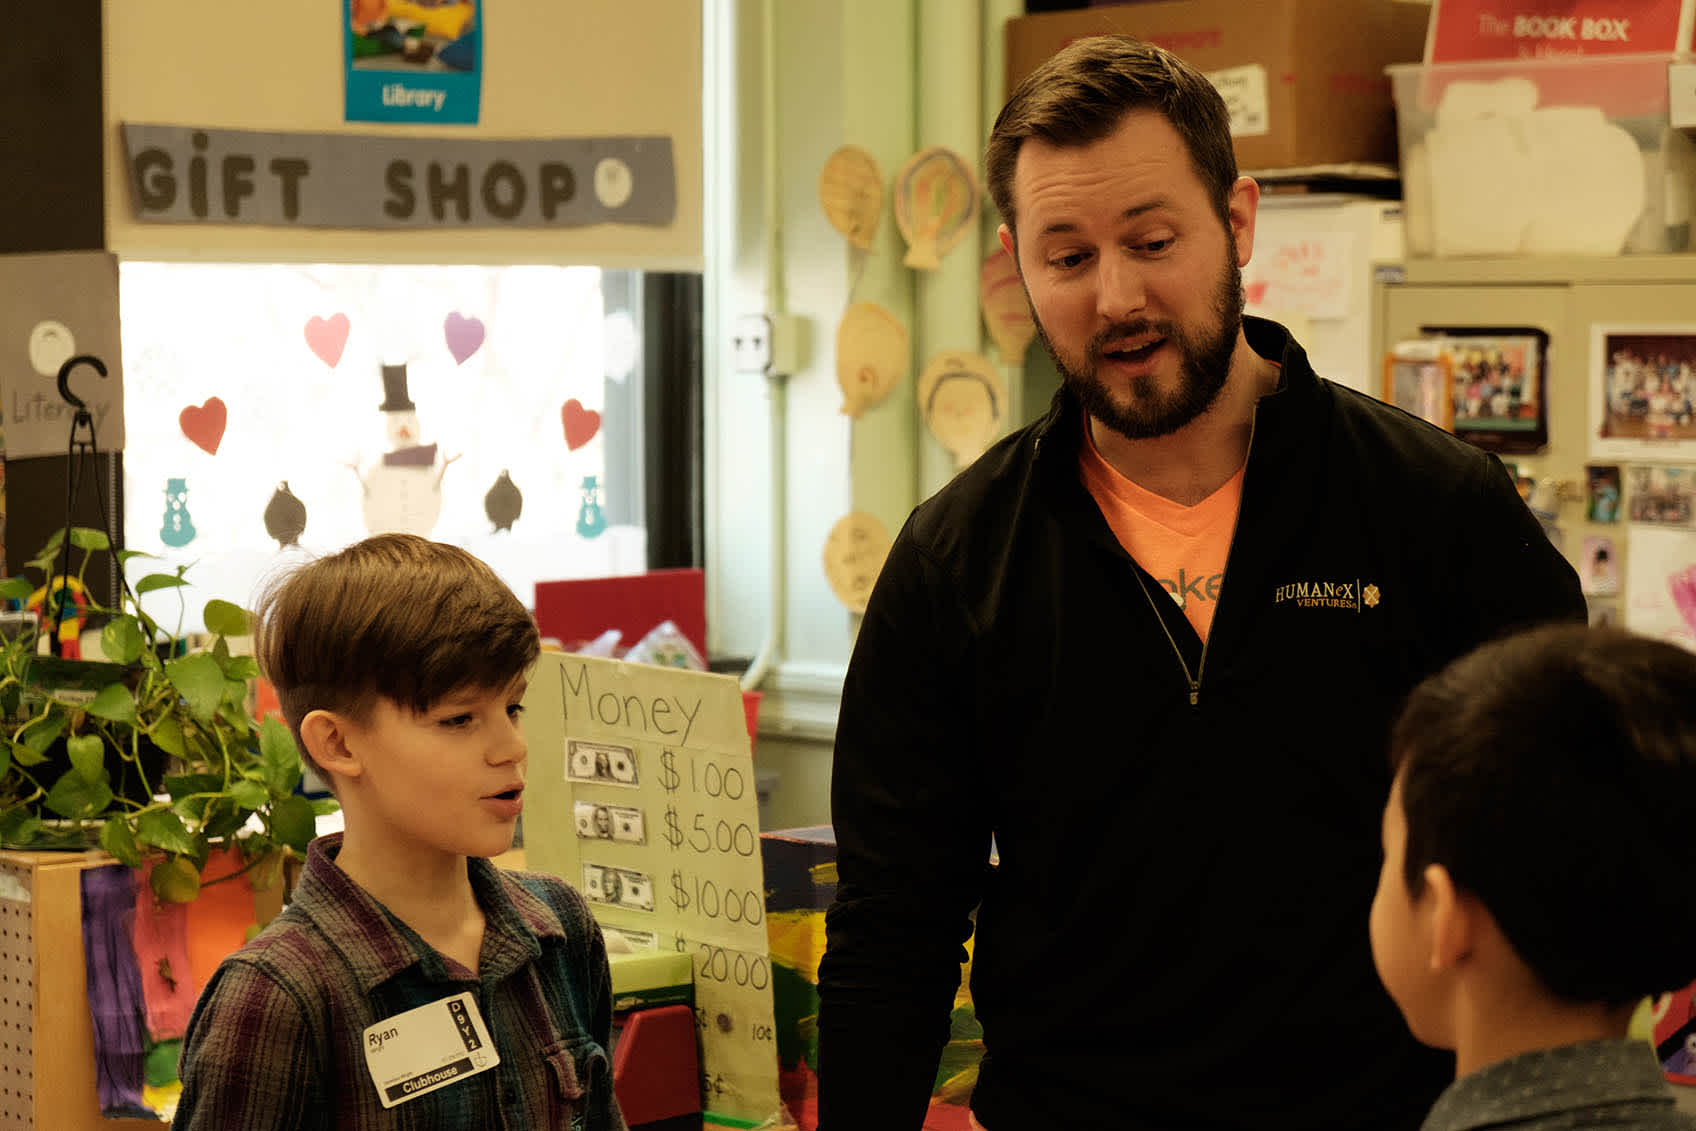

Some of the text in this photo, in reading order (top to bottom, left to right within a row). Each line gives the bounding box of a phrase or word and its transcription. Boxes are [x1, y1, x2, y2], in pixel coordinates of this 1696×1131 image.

[1513, 15, 1577, 40] BOOK
[1581, 16, 1631, 42] BOX
[382, 84, 446, 111] Library
[383, 159, 576, 222] SHOP
[13, 389, 110, 436] Litery
[560, 663, 702, 747] Money
[368, 1028, 399, 1047] Ryan
[402, 1067, 458, 1094] Clubhouse
